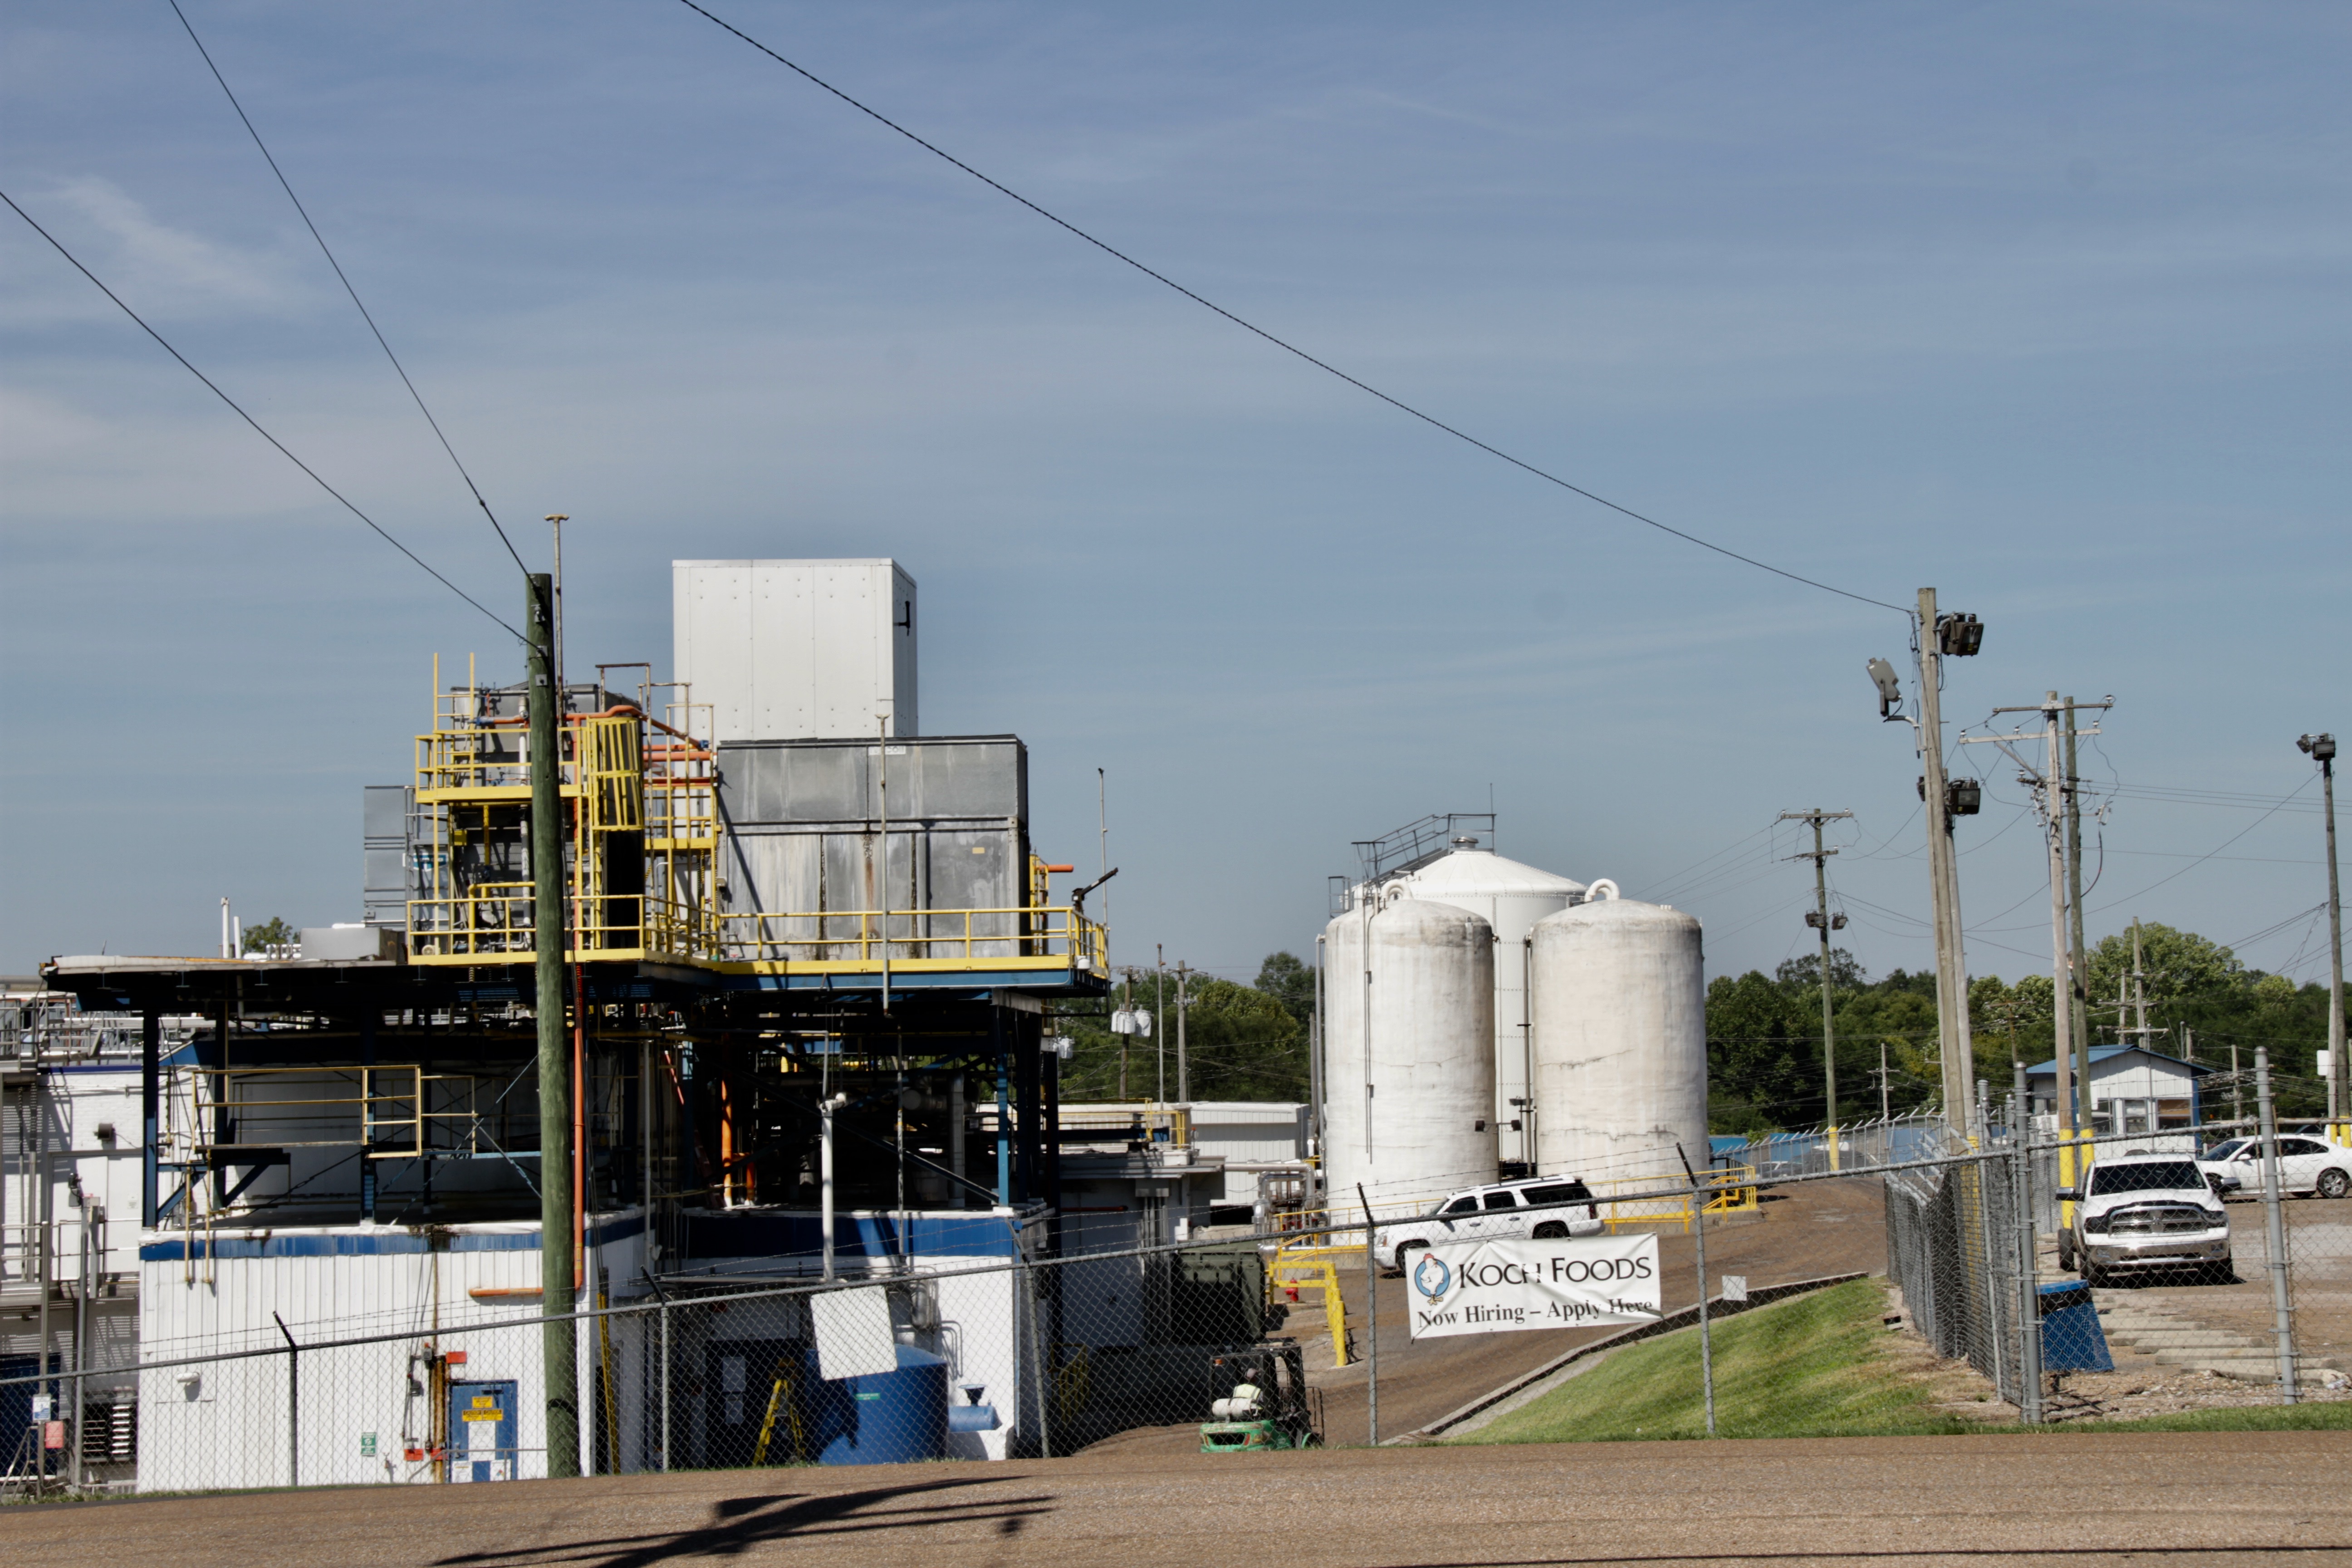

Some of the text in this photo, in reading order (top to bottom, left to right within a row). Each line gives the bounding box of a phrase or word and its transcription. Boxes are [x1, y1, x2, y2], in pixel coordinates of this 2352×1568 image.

[1458, 1256, 1651, 1289] KOCH FOODS
[1418, 1310, 1459, 1328] Now
[1465, 1304, 1525, 1324] Hiring
[1547, 1300, 1601, 1321] Apply
[1607, 1298, 1652, 1314] Here
